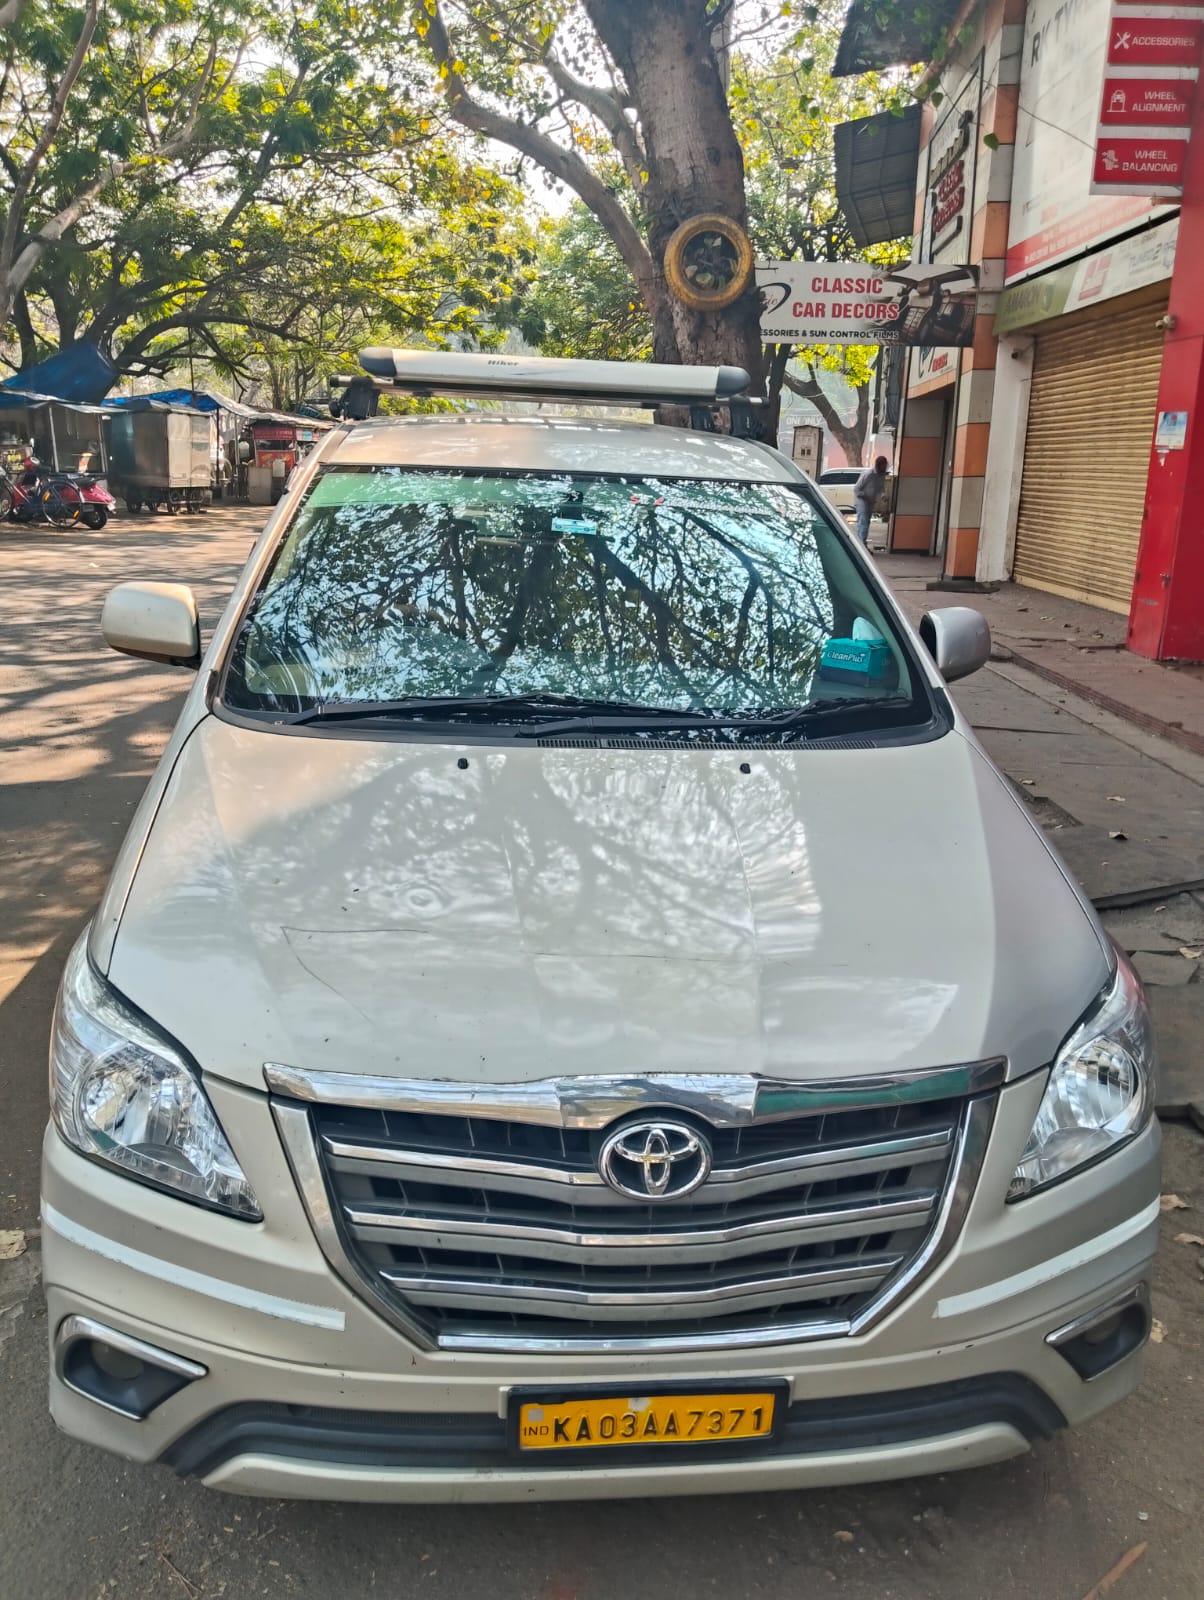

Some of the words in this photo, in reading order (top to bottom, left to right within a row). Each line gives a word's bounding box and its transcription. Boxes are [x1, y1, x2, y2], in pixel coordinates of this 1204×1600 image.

[1132, 36, 1195, 47] ACCESSORIES
[1144, 91, 1176, 101] WHEEL
[1132, 103, 1186, 113] ALIGNMENT
[1134, 150, 1168, 160] WHEEL
[1122, 162, 1178, 173] BALANCING
[811, 276, 883, 294] CLASSIC
[792, 301, 826, 318] CAR
[831, 302, 900, 320] DECORS
[801, 329, 807, 337] &
[810, 329, 828, 338] SUN
[829, 330, 872, 339] CONTROL
[873, 330, 899, 340] FILMS
[523, 1425, 549, 1437] IND
[553, 1407, 763, 1442] KA03AA7371
